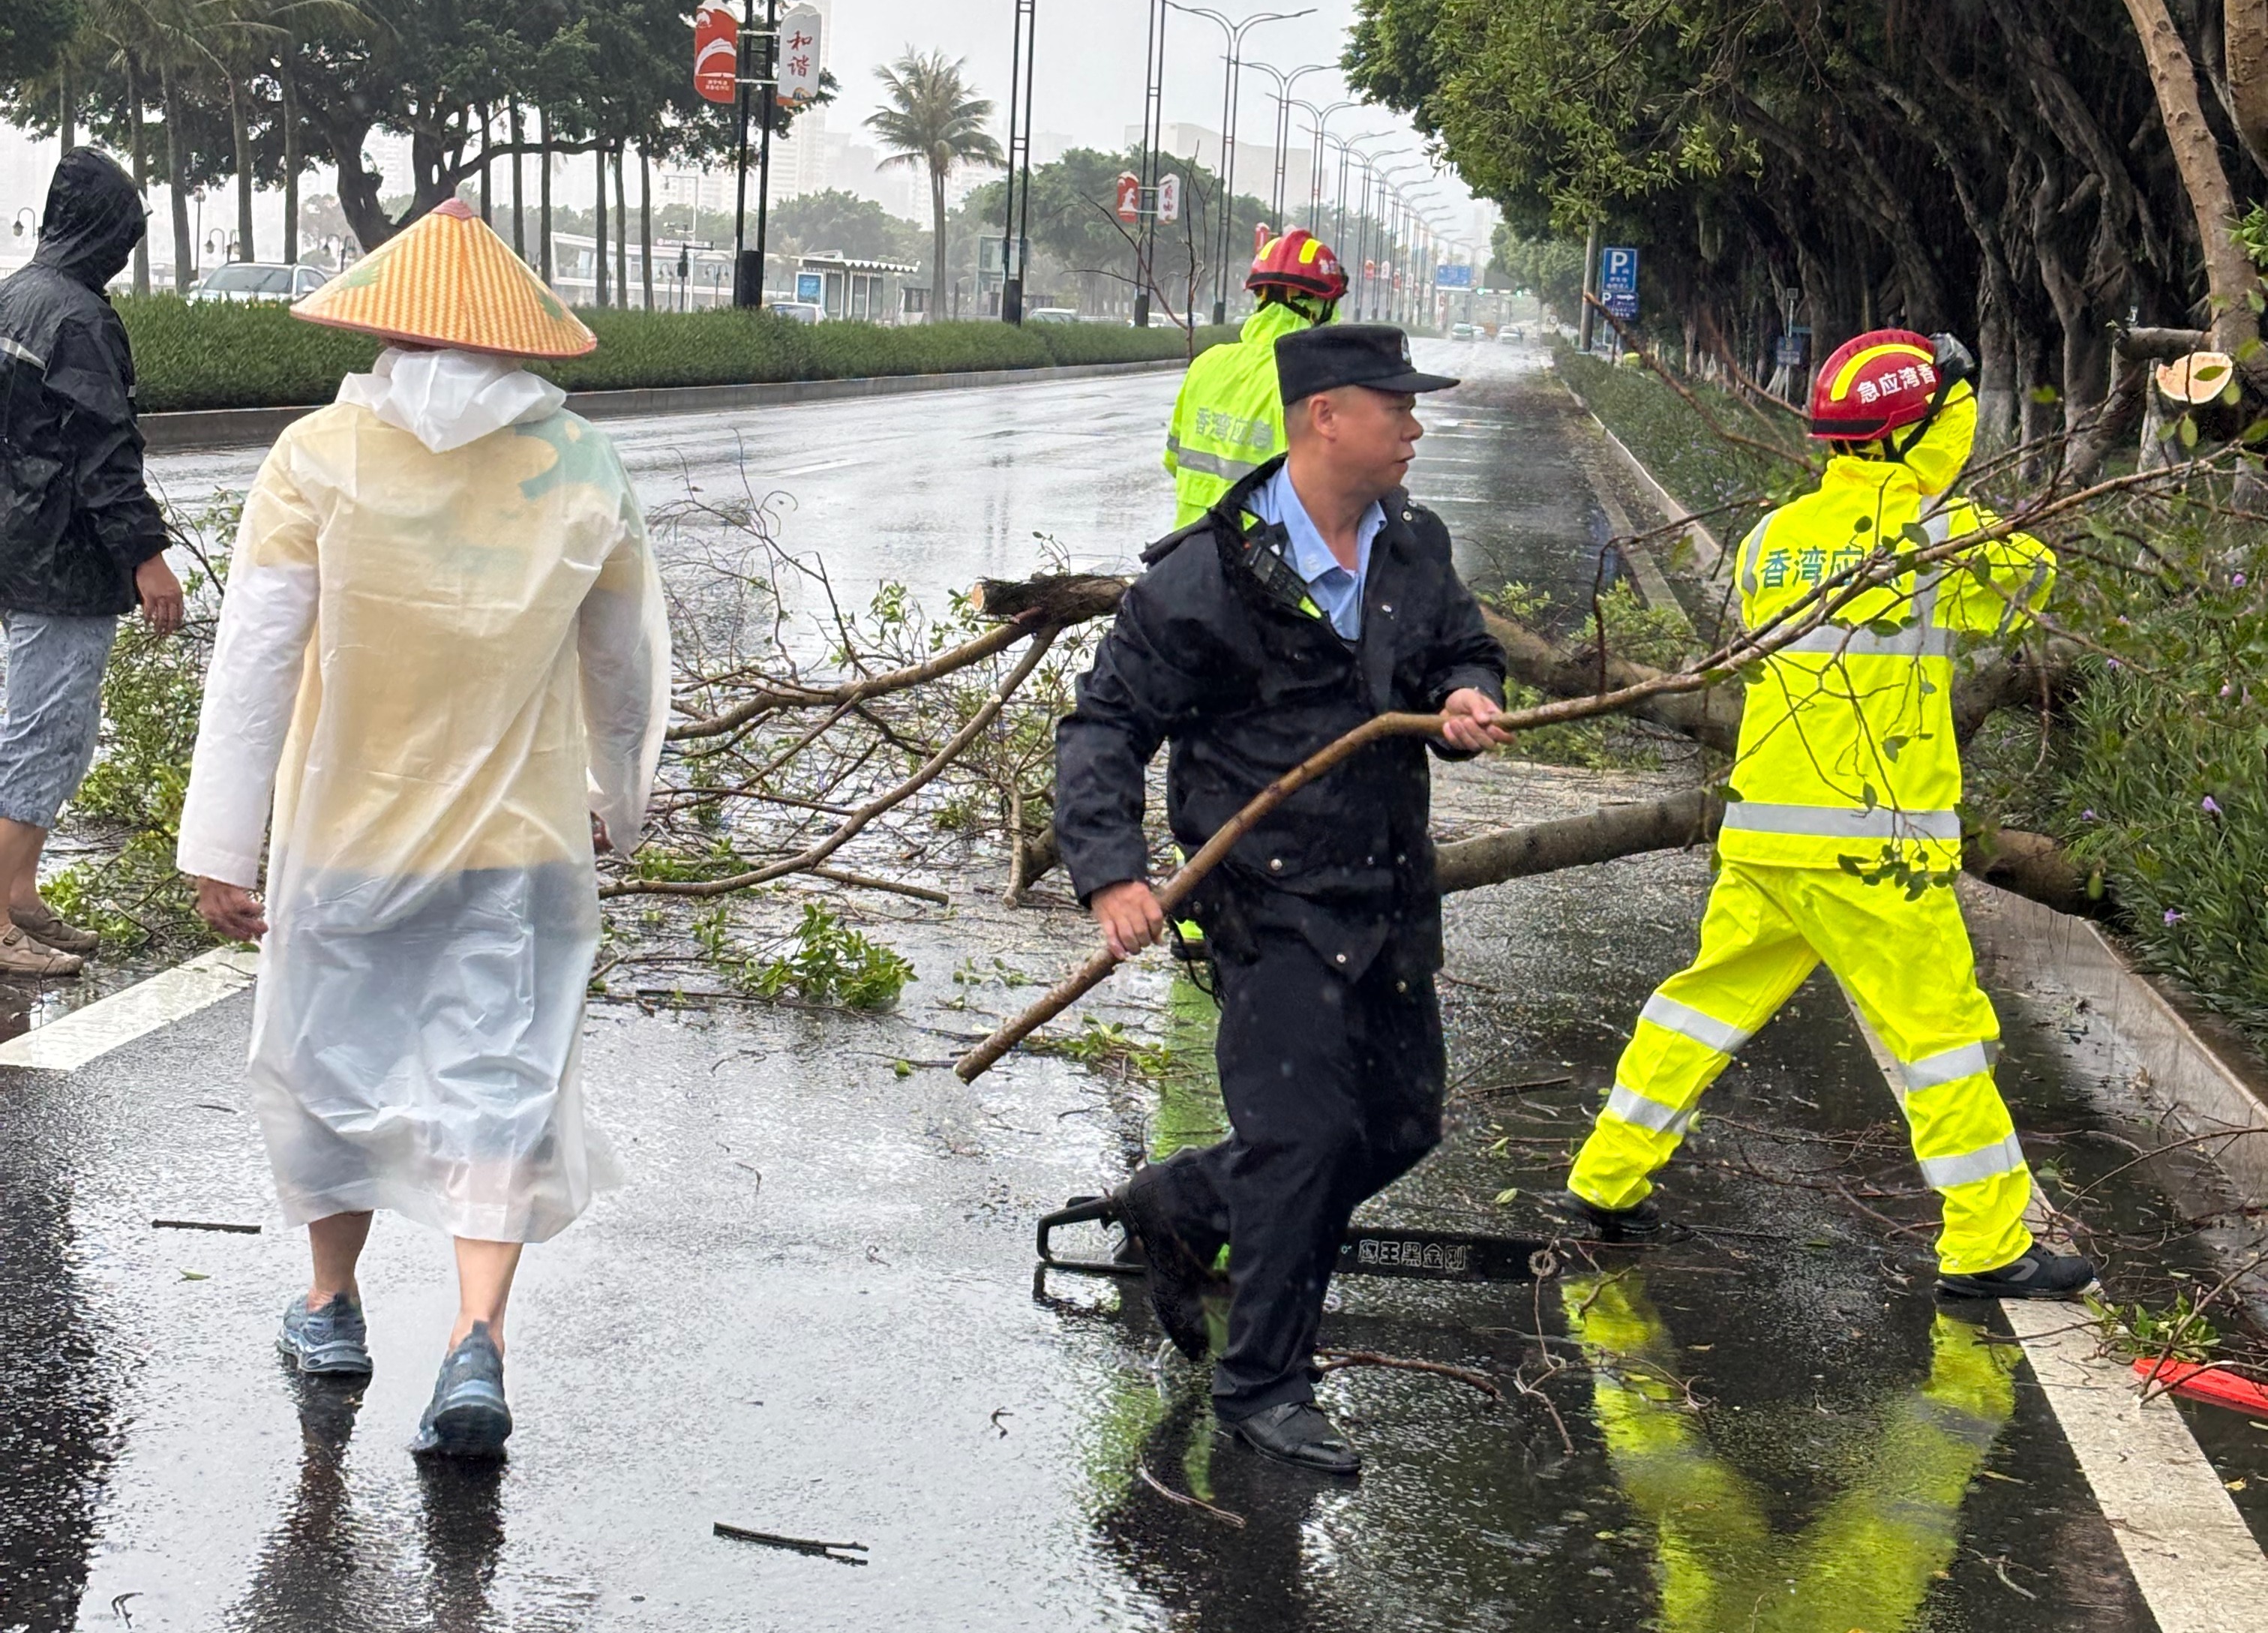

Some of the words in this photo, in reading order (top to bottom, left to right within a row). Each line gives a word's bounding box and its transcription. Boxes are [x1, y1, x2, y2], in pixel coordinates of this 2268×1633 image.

[786, 29, 814, 78] 和谐
[1610, 251, 1628, 275] P
[1601, 292, 1612, 305] P
[1760, 544, 1902, 589] 香湾应
